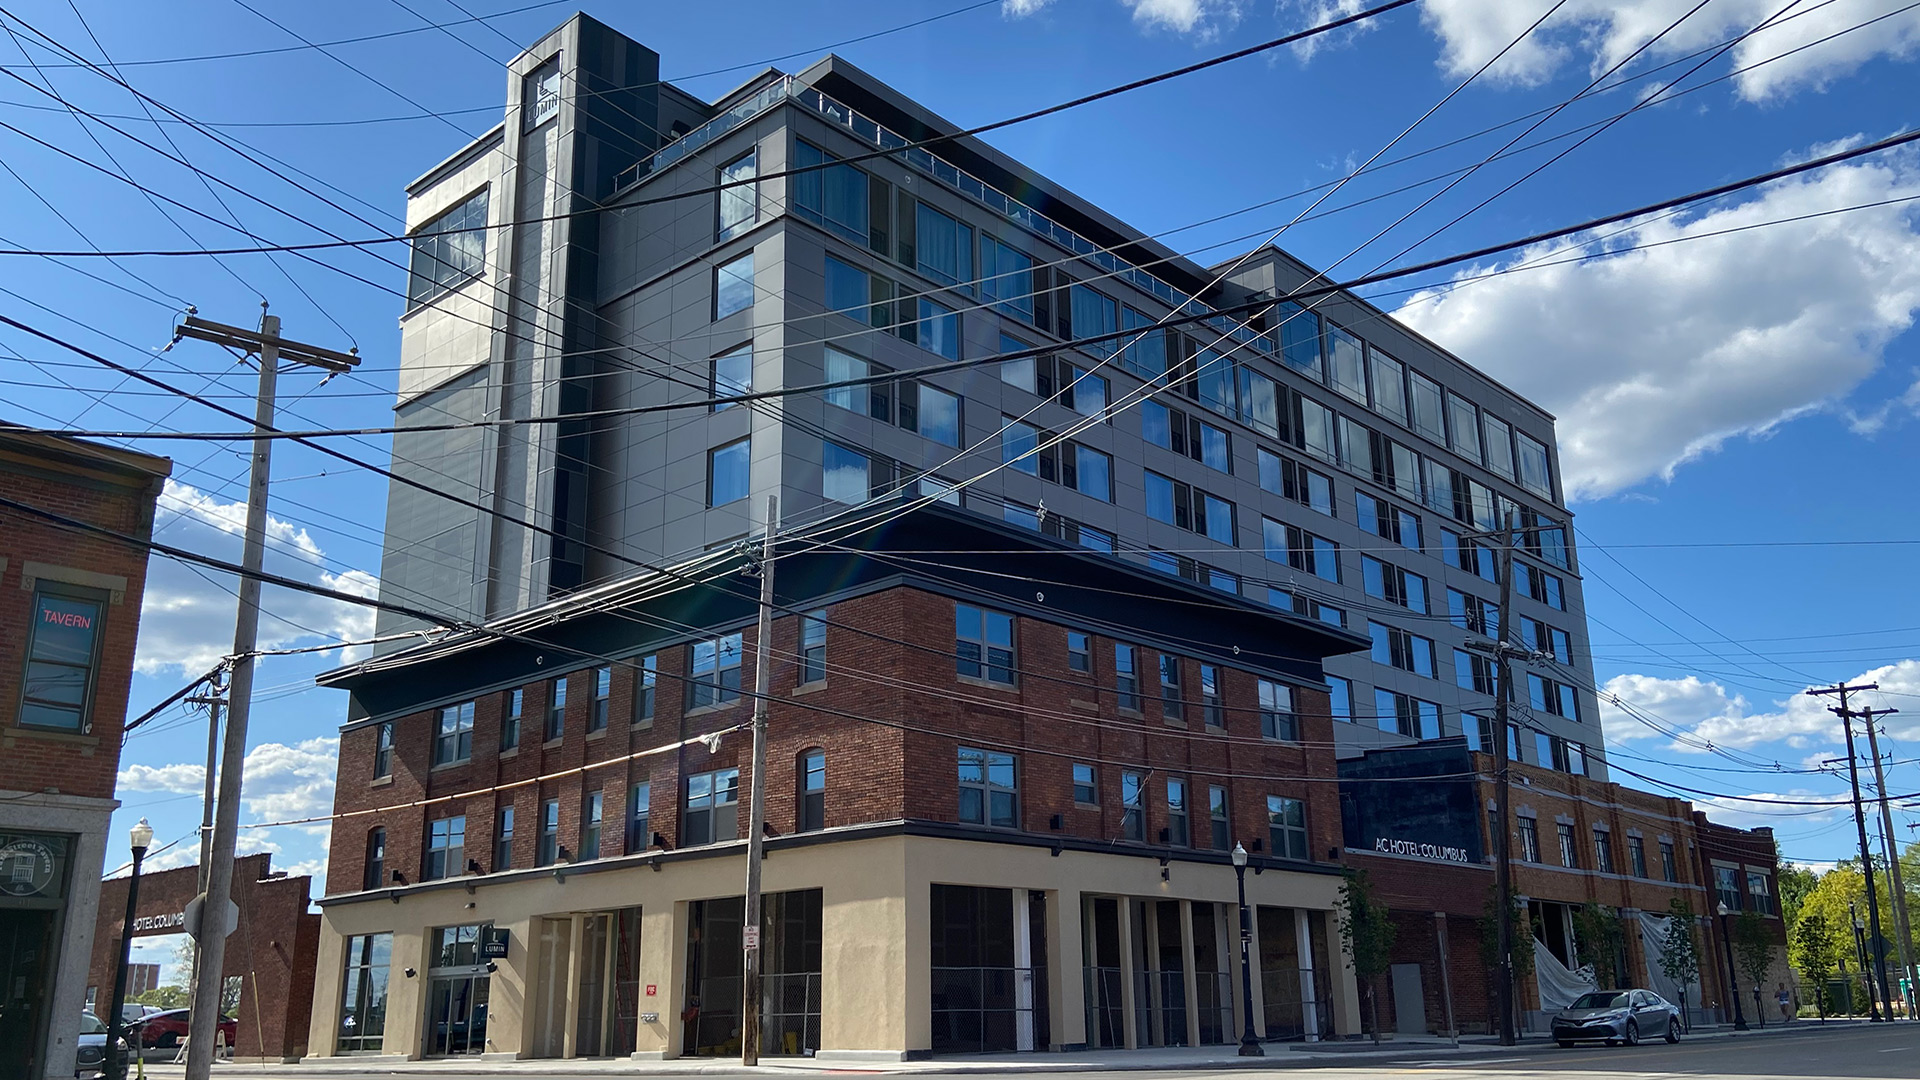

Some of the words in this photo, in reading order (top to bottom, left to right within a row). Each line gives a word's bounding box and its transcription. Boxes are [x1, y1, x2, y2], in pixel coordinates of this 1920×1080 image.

[527, 95, 558, 123] LUMIN
[44, 609, 91, 629] TAVERN
[37, 846, 51, 873] Tavern
[1375, 837, 1389, 852] AC
[1389, 839, 1420, 856] HOTEL
[1421, 843, 1468, 862] COLUMBUS
[154, 911, 186, 929] COLUMB
[485, 945, 505, 953] LUMIN
